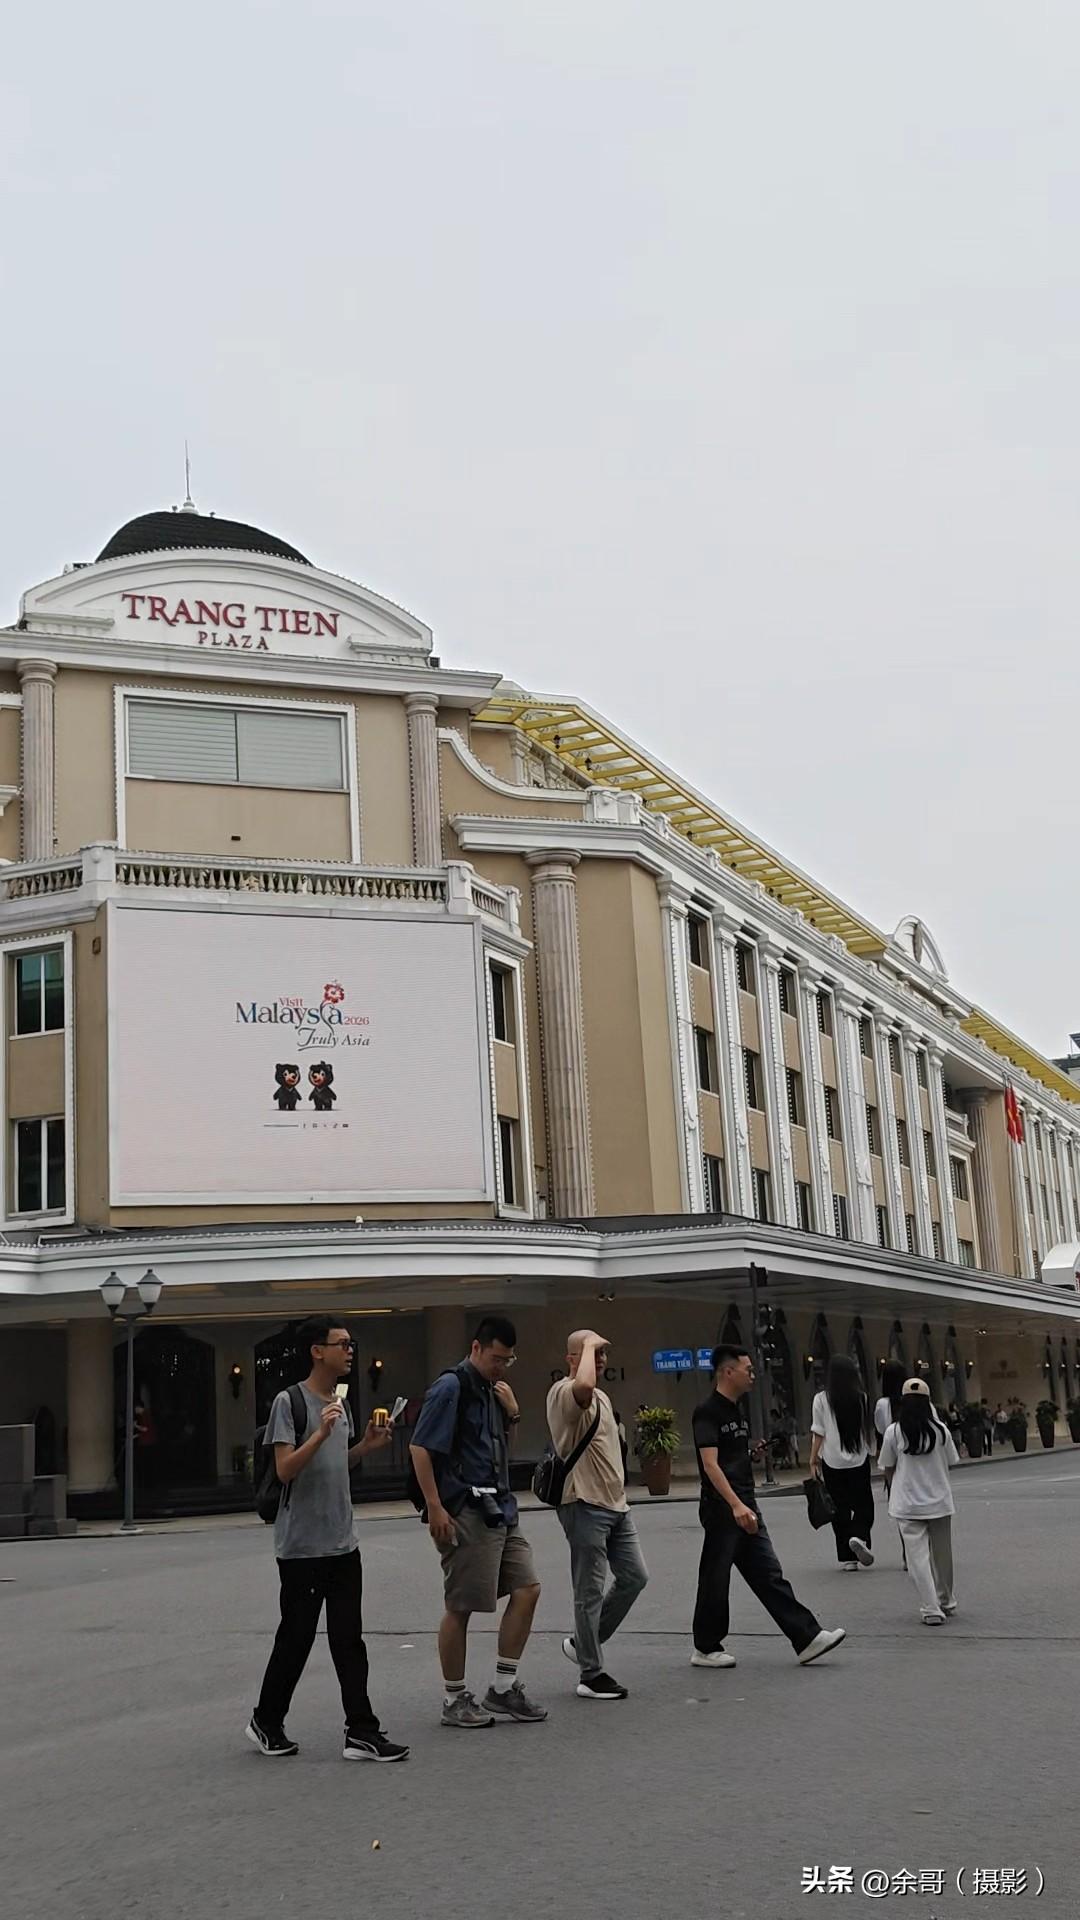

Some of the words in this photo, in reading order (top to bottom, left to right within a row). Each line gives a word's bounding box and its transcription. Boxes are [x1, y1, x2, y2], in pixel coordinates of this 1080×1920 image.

[121, 593, 246, 628] TRANG
[255, 606, 340, 637] TIEN
[198, 631, 269, 650] PLAZA
[279, 997, 304, 1007] Visit
[235, 1000, 343, 1031] Malaysia
[343, 1015, 370, 1026] 2026
[297, 1027, 339, 1049] Truly
[341, 1034, 370, 1047] Asia
